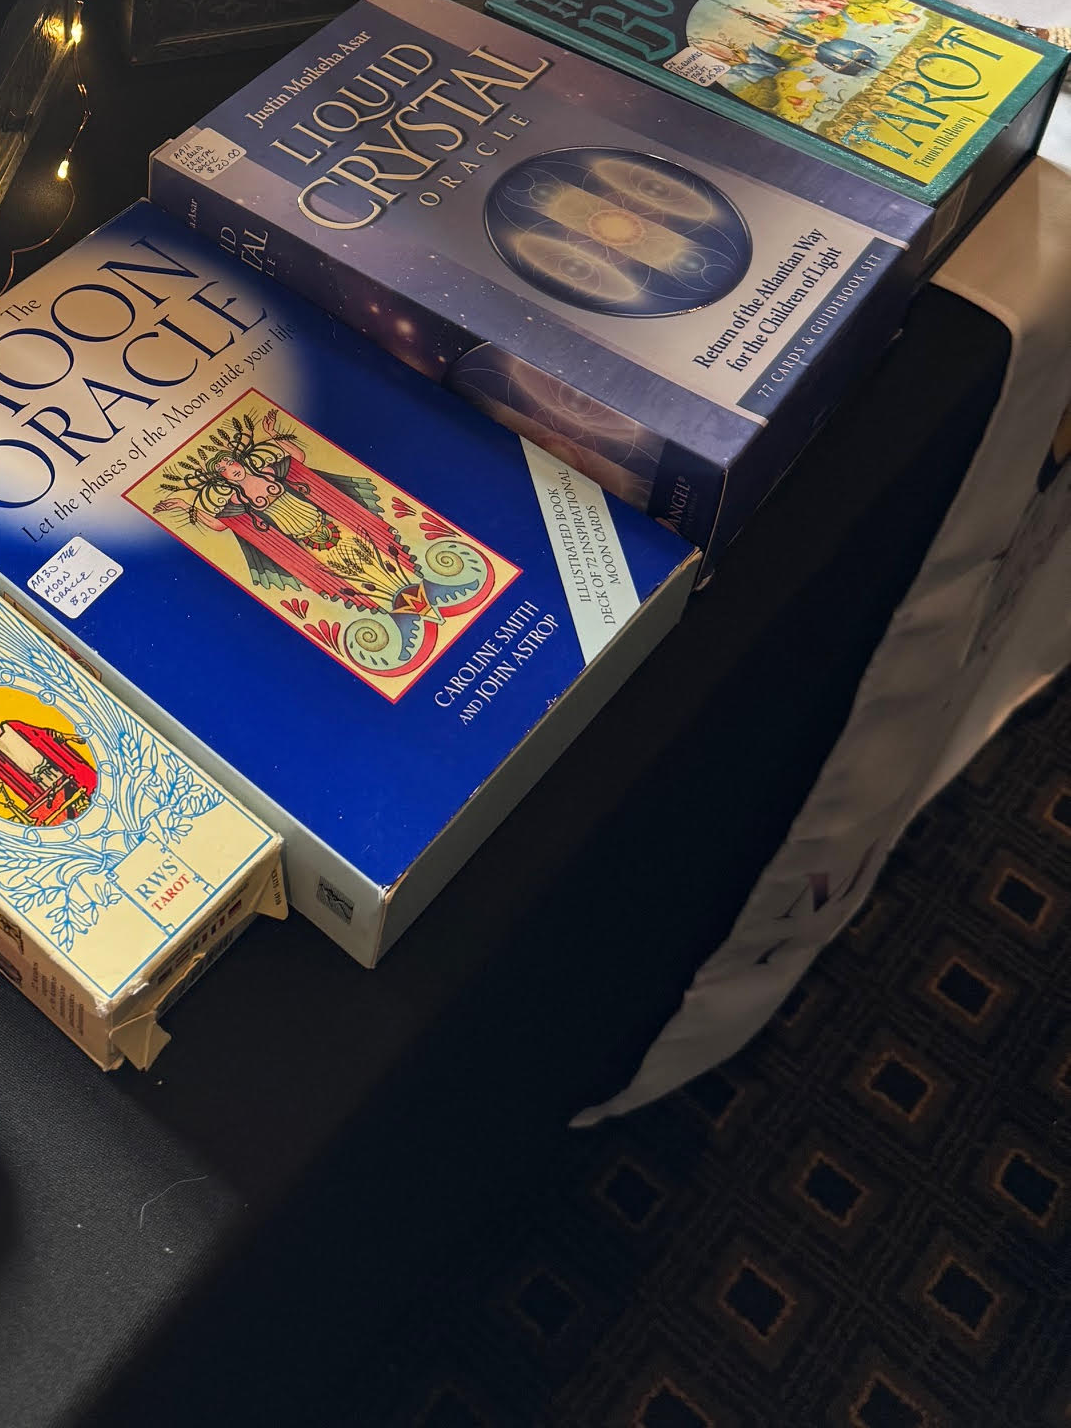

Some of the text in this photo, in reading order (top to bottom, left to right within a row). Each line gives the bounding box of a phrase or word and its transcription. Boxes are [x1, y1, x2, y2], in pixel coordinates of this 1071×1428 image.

[244, 29, 373, 129] Justin Moikeha Asar
[269, 42, 434, 166] LIQUID
[841, 26, 1004, 160] TAROT
[296, 45, 550, 231] CRYSTAL
[417, 112, 533, 208] ORACLE
[934, 115, 976, 153] McHenry
[0, 297, 44, 325] The
[691, 227, 828, 370] Return of the Atlantian Way
[725, 246, 843, 373] for the Children of Light
[757, 252, 883, 399] 77 CARDS & GUIDEBOOK SET
[21, 514, 56, 545] Let
[53, 496, 81, 526] the
[79, 458, 128, 504] phases
[128, 432, 152, 461] of
[143, 421, 168, 451] the
[162, 388, 212, 433] Moon
[210, 362, 245, 397] guide
[241, 337, 276, 371] your
[44, 570, 71, 598] MOON
[52, 570, 94, 604] ORACLE
[57, 545, 81, 564] THE
[547, 487, 593, 603] ILLUSTRATED BOOK
[557, 469, 617, 625] DECK OF 72 INSPIRATIONAL
[585, 503, 621, 585] MOON CARDS
[434, 600, 540, 708] CAROLINE SMITH
[459, 613, 560, 726] AND JOHN ASTROP
[134, 857, 179, 902] RWS
[150, 873, 193, 913] TAROT
